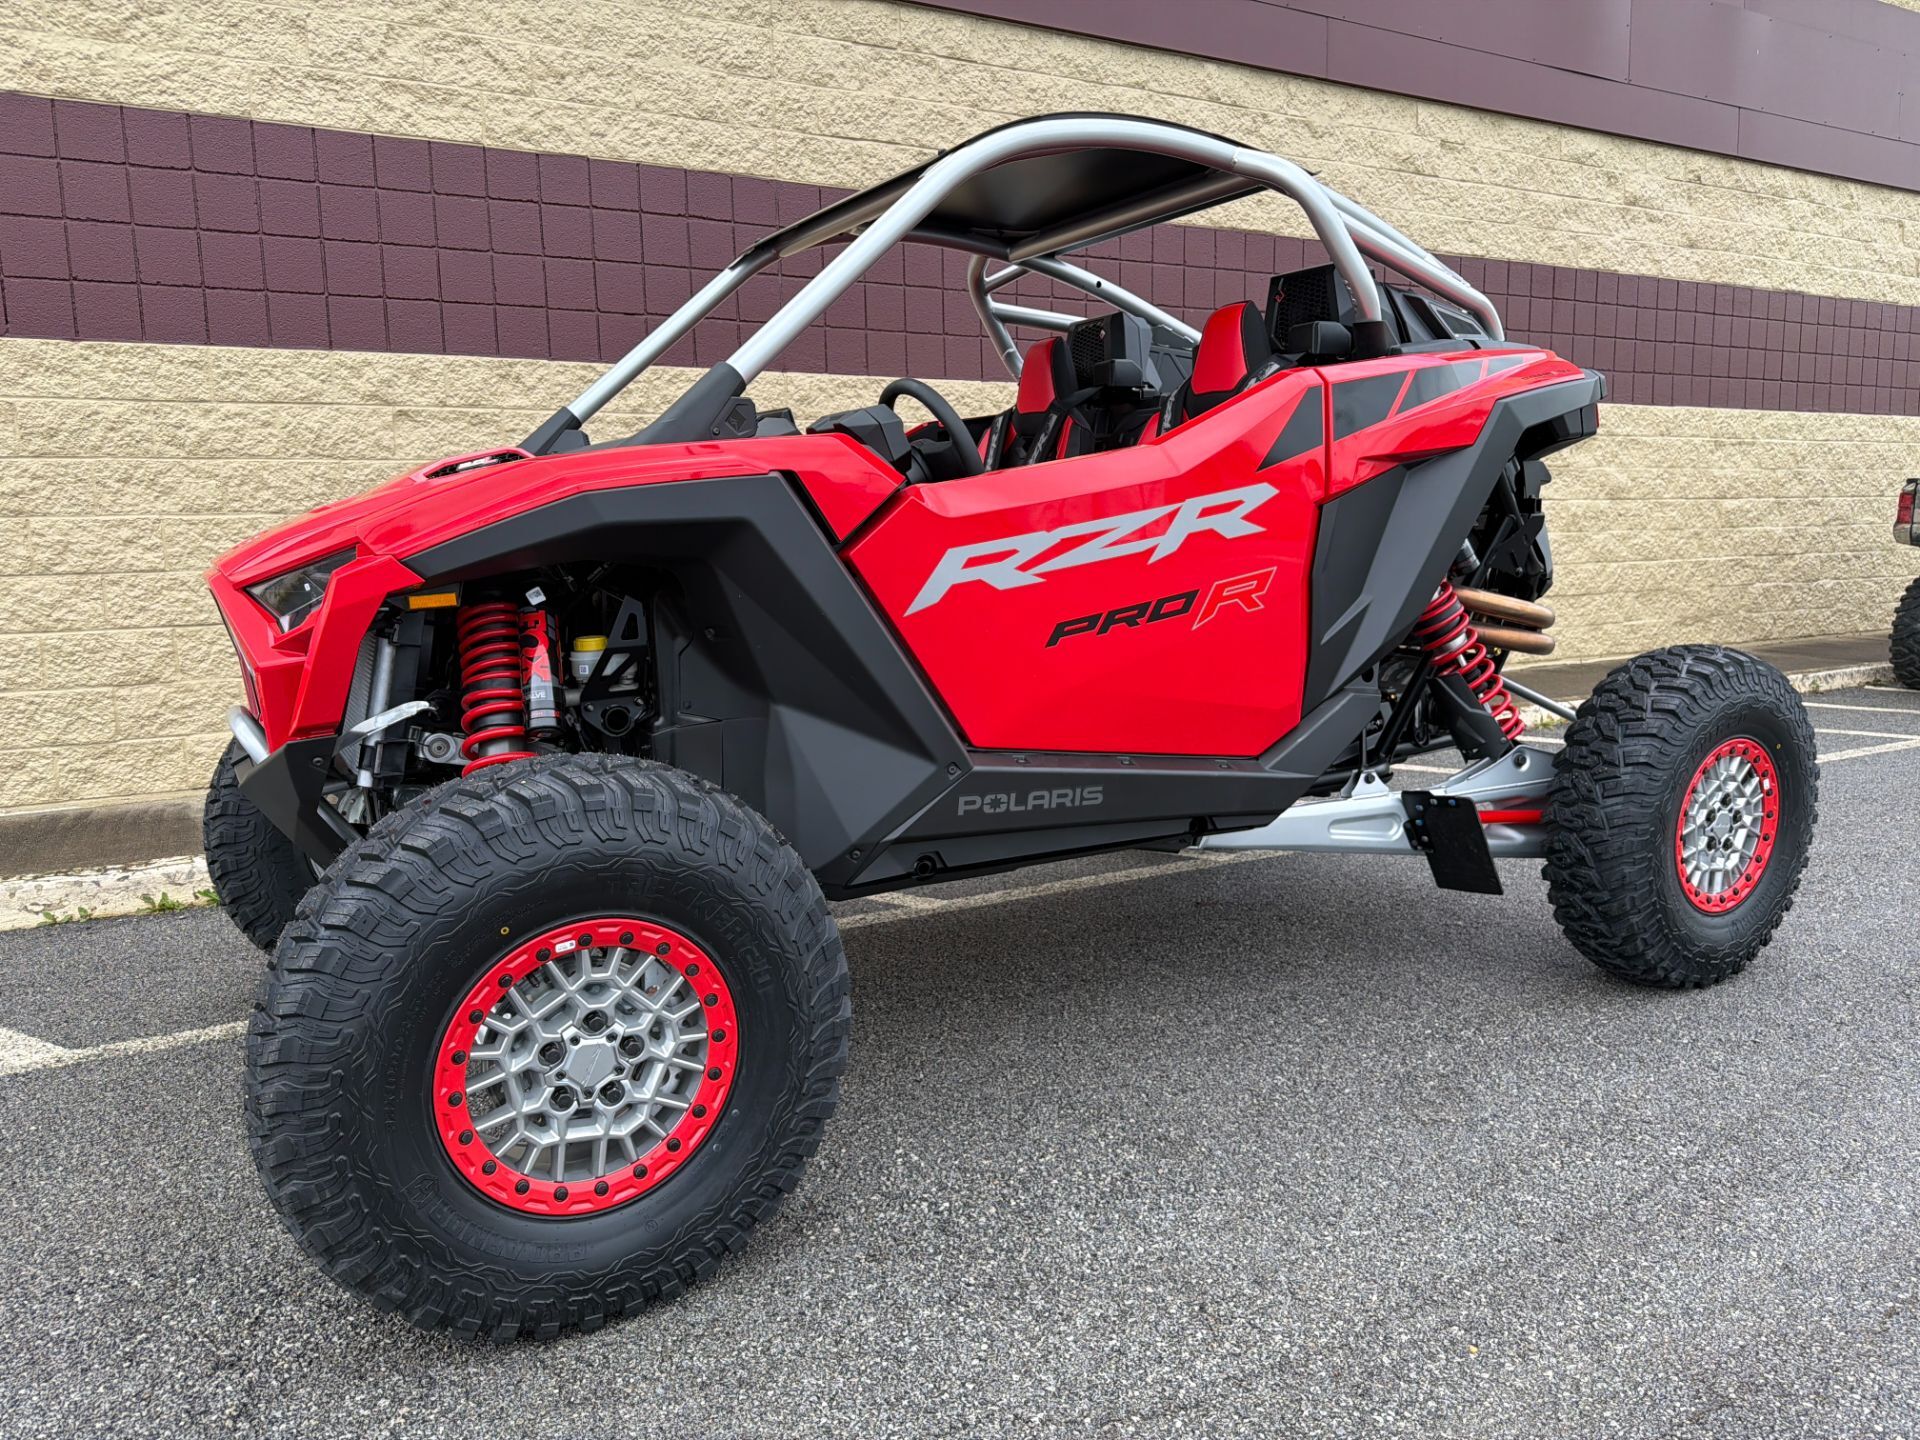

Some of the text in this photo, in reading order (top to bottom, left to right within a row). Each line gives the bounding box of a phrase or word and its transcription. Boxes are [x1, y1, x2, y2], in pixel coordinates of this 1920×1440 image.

[903, 482, 1280, 617] RZR
[1045, 566, 1278, 648] PRO R
[520, 610, 550, 686] FOX
[957, 786, 1104, 816] POLARIS
